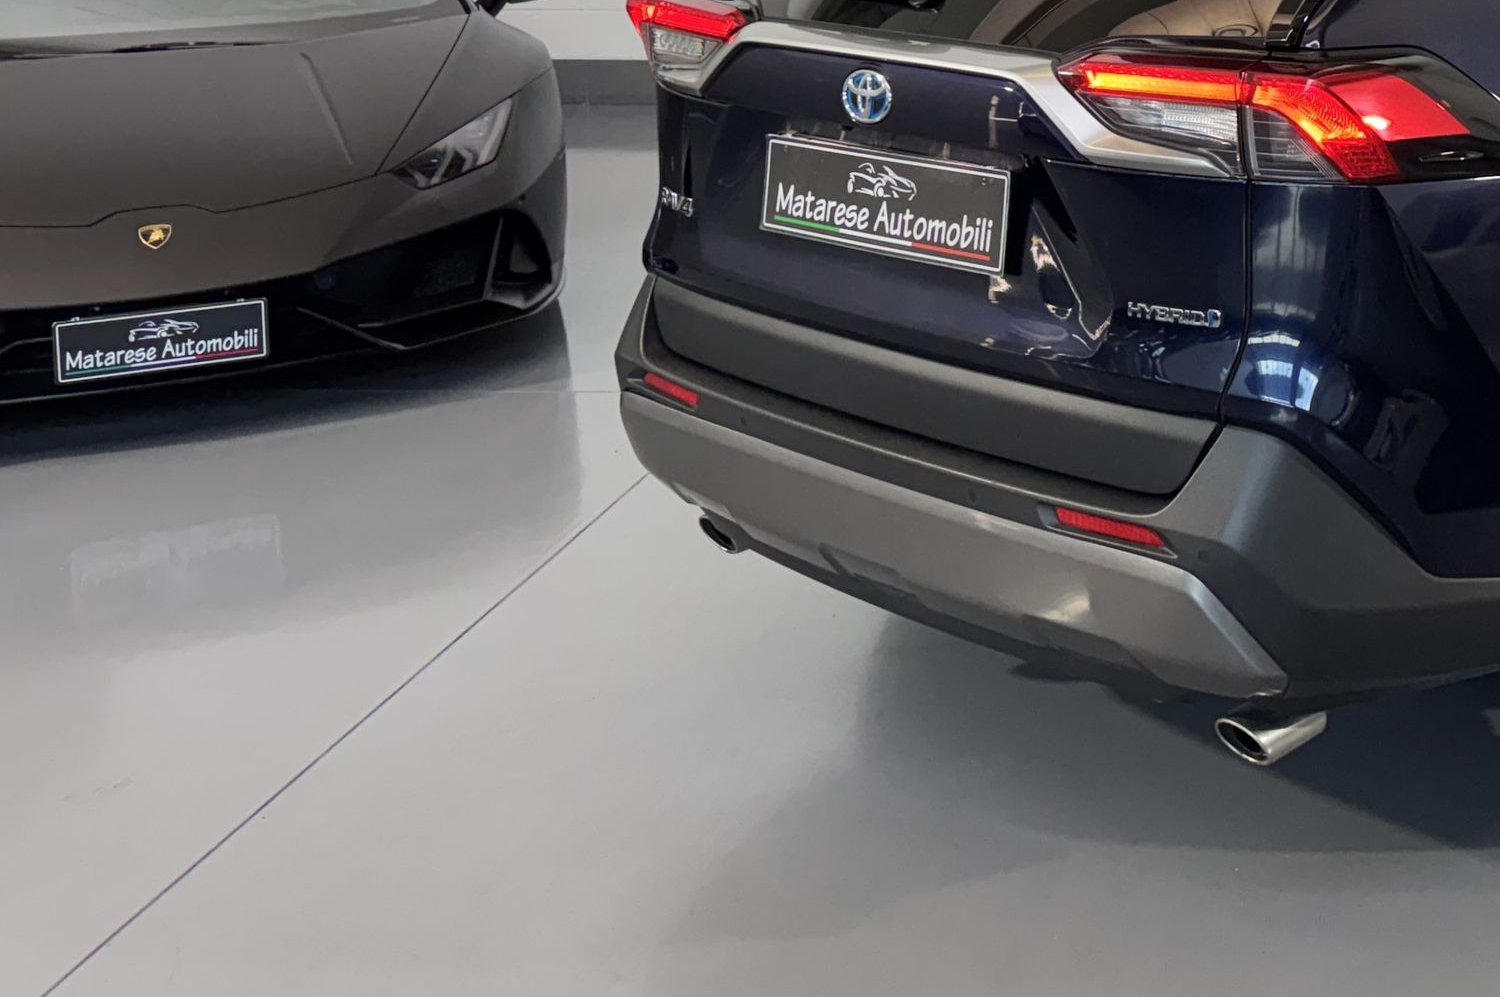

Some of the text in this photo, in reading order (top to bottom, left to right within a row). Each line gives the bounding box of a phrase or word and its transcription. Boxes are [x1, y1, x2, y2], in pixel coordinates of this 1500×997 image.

[775, 181, 993, 253] Matarese Automobili
[1127, 301, 1205, 327] HYBRID
[66, 328, 259, 372] Matarese Automobili
